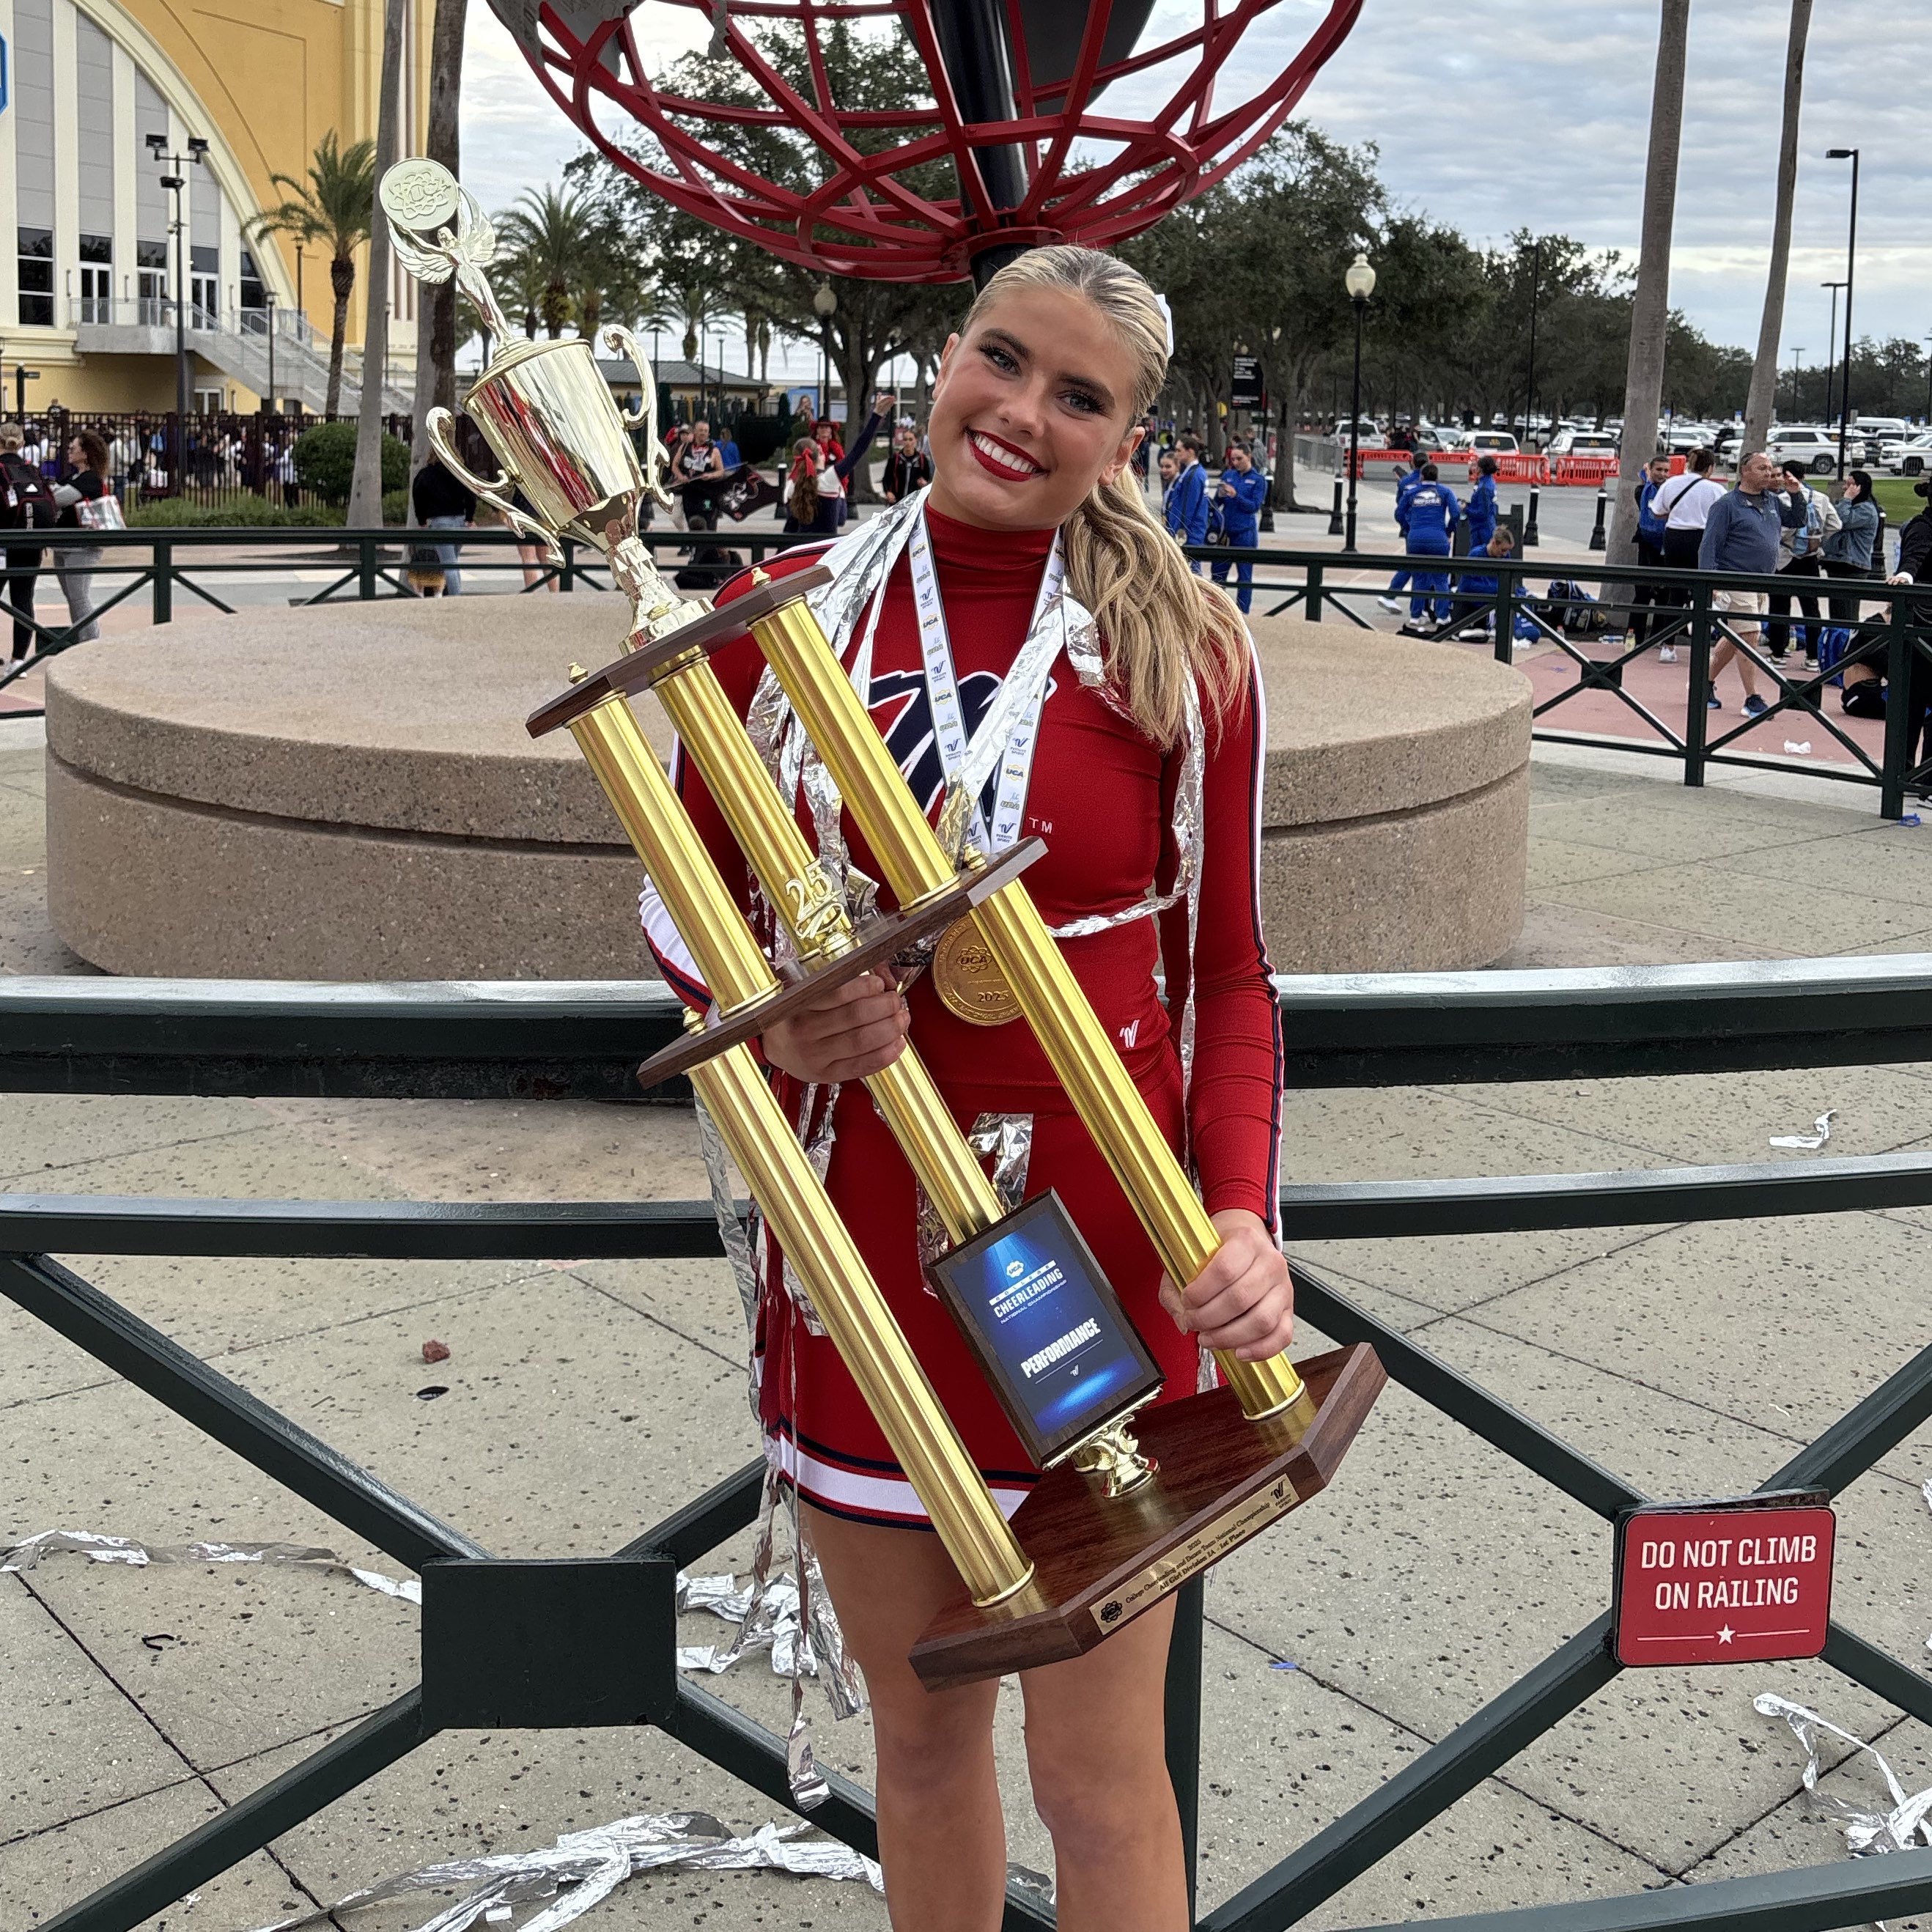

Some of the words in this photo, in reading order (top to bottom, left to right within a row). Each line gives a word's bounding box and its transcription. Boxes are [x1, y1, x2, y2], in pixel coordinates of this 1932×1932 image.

[934, 692, 953, 703] UCA
[1006, 769, 1024, 778] UCA
[1029, 816, 1053, 834] TM
[960, 954, 988, 965] UCA
[977, 989, 1010, 1003] 2025
[993, 1268, 1063, 1318] CHEERLEADING
[1020, 1317, 1102, 1379] PERFORMANCE
[1641, 1541, 1676, 1568] DO
[1683, 1539, 1733, 1568] NOT
[1738, 1535, 1817, 1566] CLIMB
[1655, 1582, 1690, 1610] ON
[1697, 1577, 1799, 1609] RAILING
